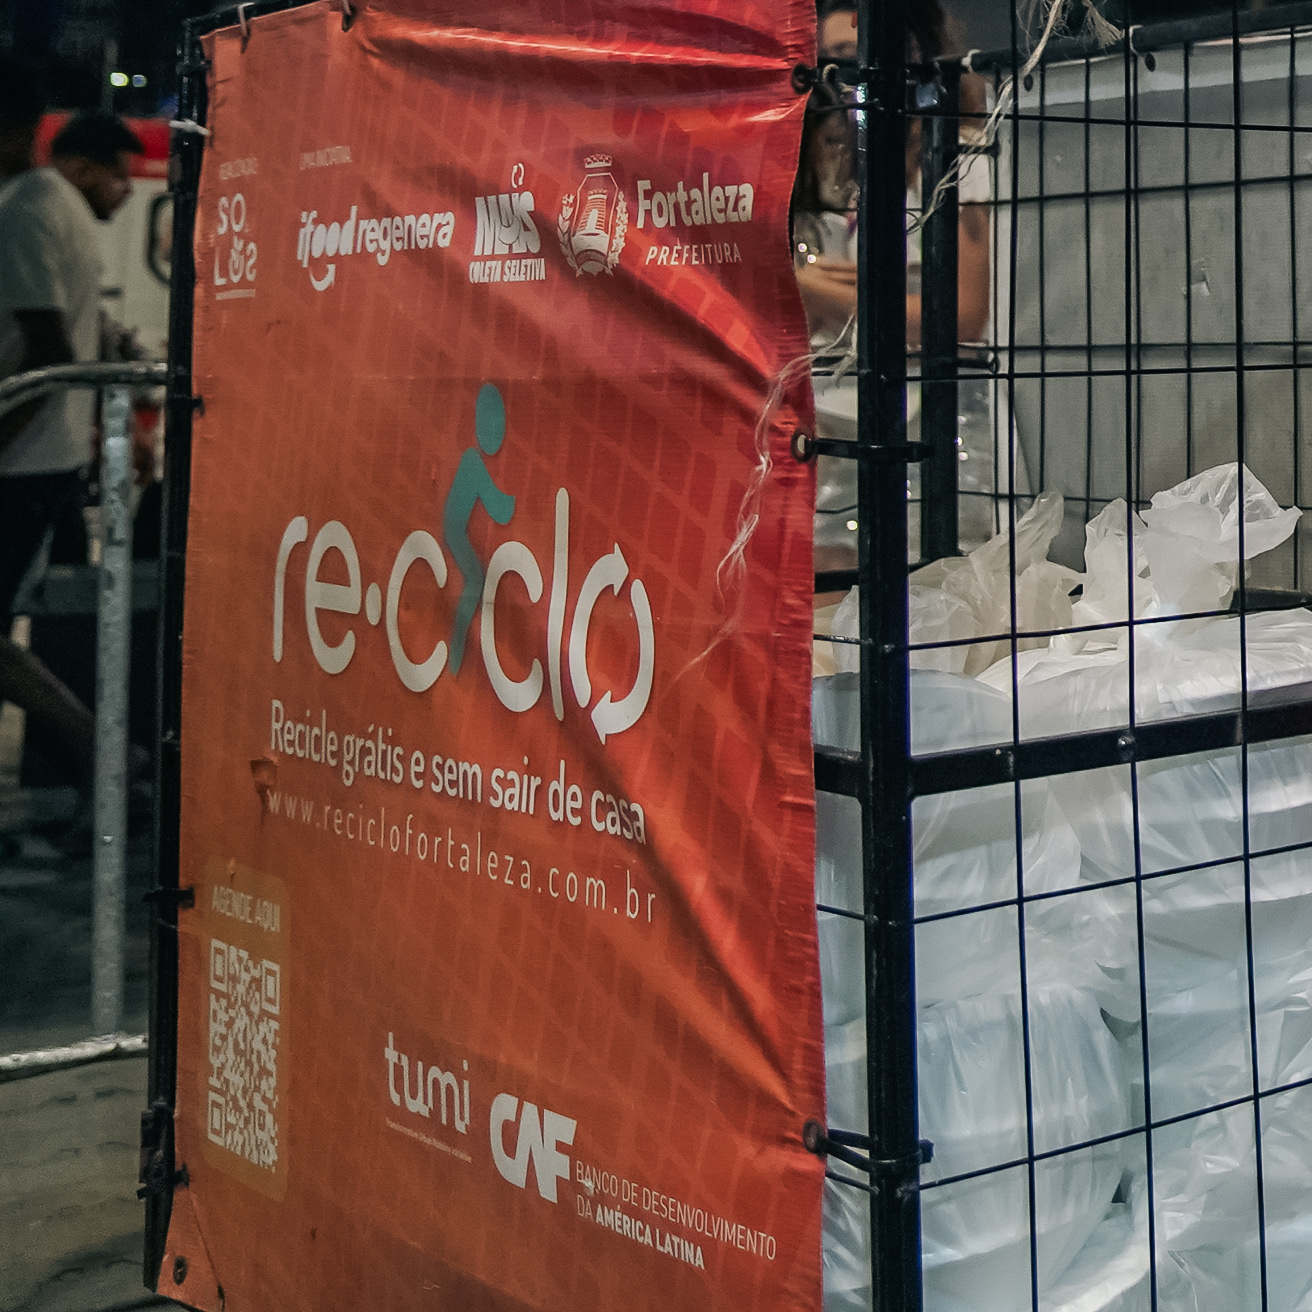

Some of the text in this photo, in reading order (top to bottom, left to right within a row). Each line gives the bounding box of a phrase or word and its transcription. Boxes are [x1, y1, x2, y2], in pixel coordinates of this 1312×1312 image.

[637, 172, 754, 229] Fortaleza
[469, 258, 546, 283] COLETA SELETIVA
[645, 242, 743, 266] PREFEITURA
[271, 699, 647, 845] Recicle grátis e sem sair de casa
[267, 789, 656, 924] www.reciclofortaleza.com.br
[384, 1032, 470, 1135] tumi
[490, 1093, 577, 1204] CAF
[576, 1160, 777, 1261] BANCO DE DESENVOLVIMENTO
[576, 1194, 706, 1271] DA AMÉRICA LATINA
